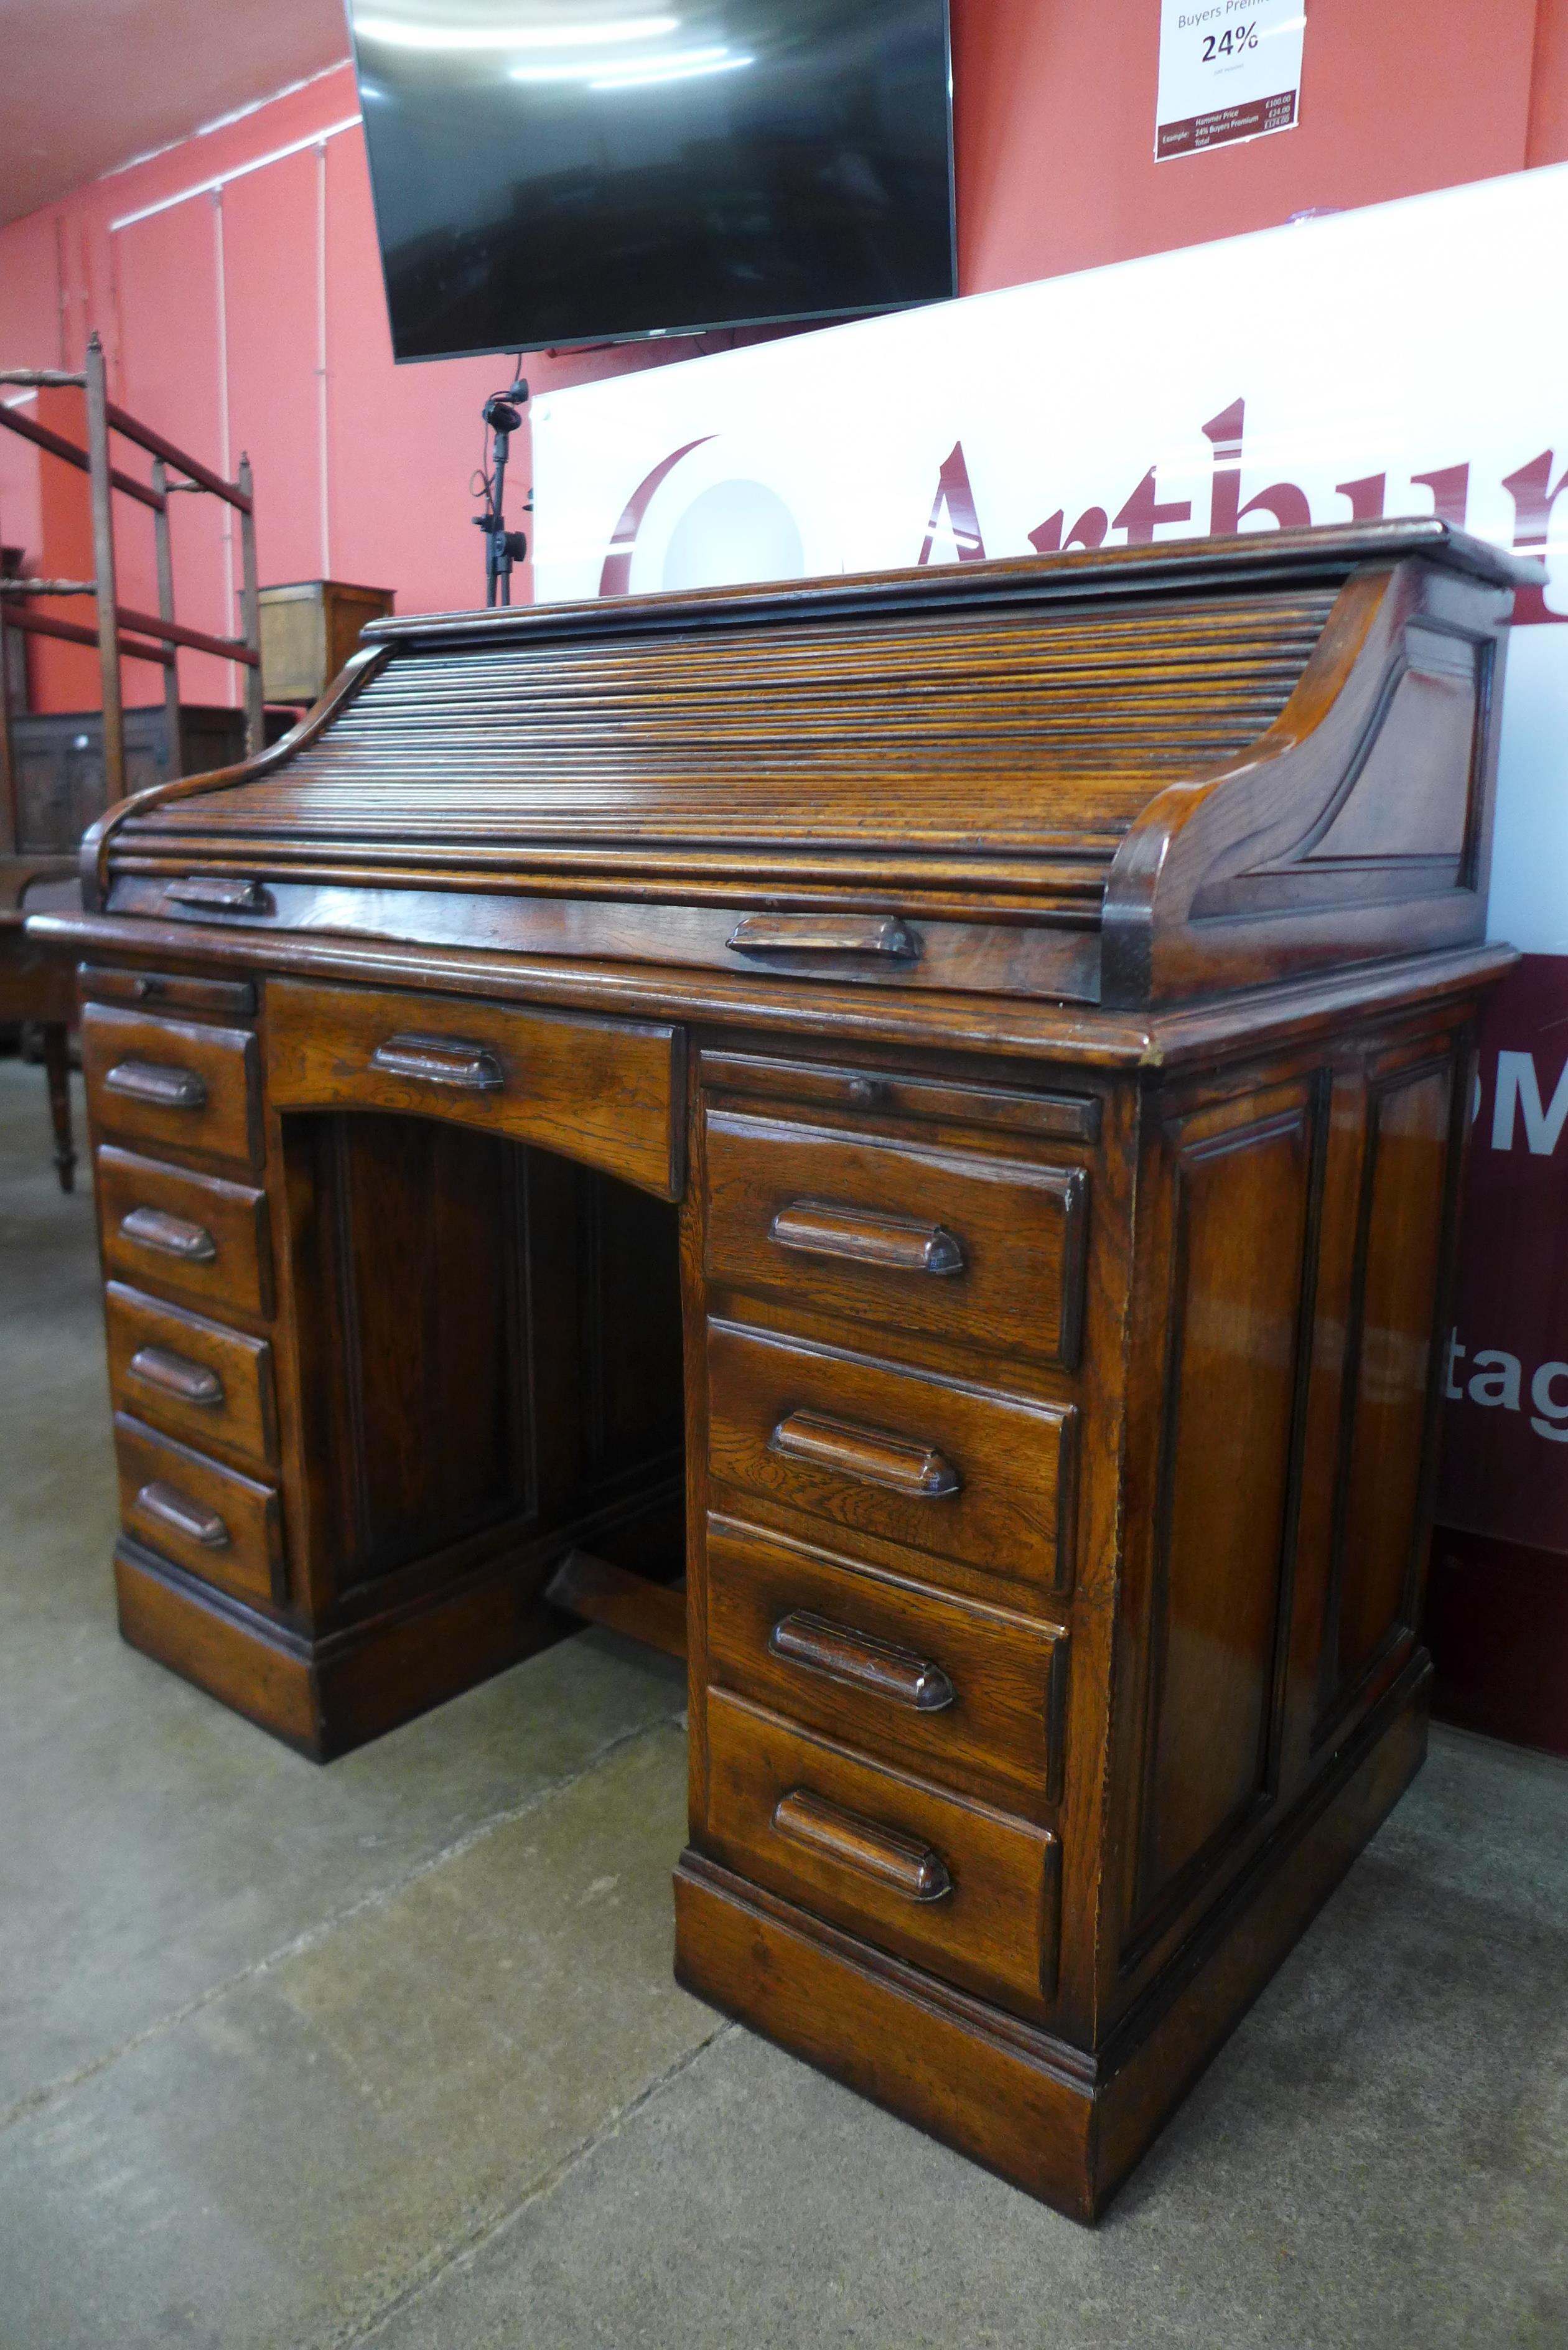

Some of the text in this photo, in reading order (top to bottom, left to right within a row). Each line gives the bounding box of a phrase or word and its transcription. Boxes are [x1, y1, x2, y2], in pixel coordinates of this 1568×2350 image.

[1178, 0, 1270, 29] Buyers Prem
[1202, 21, 1258, 63] 24%
[1195, 114, 1222, 126] Hammer
[1223, 110, 1239, 119] Price
[1210, 123, 1230, 134] Buyers
[1231, 115, 1259, 129] Premium
[1195, 137, 1210, 147] Total
